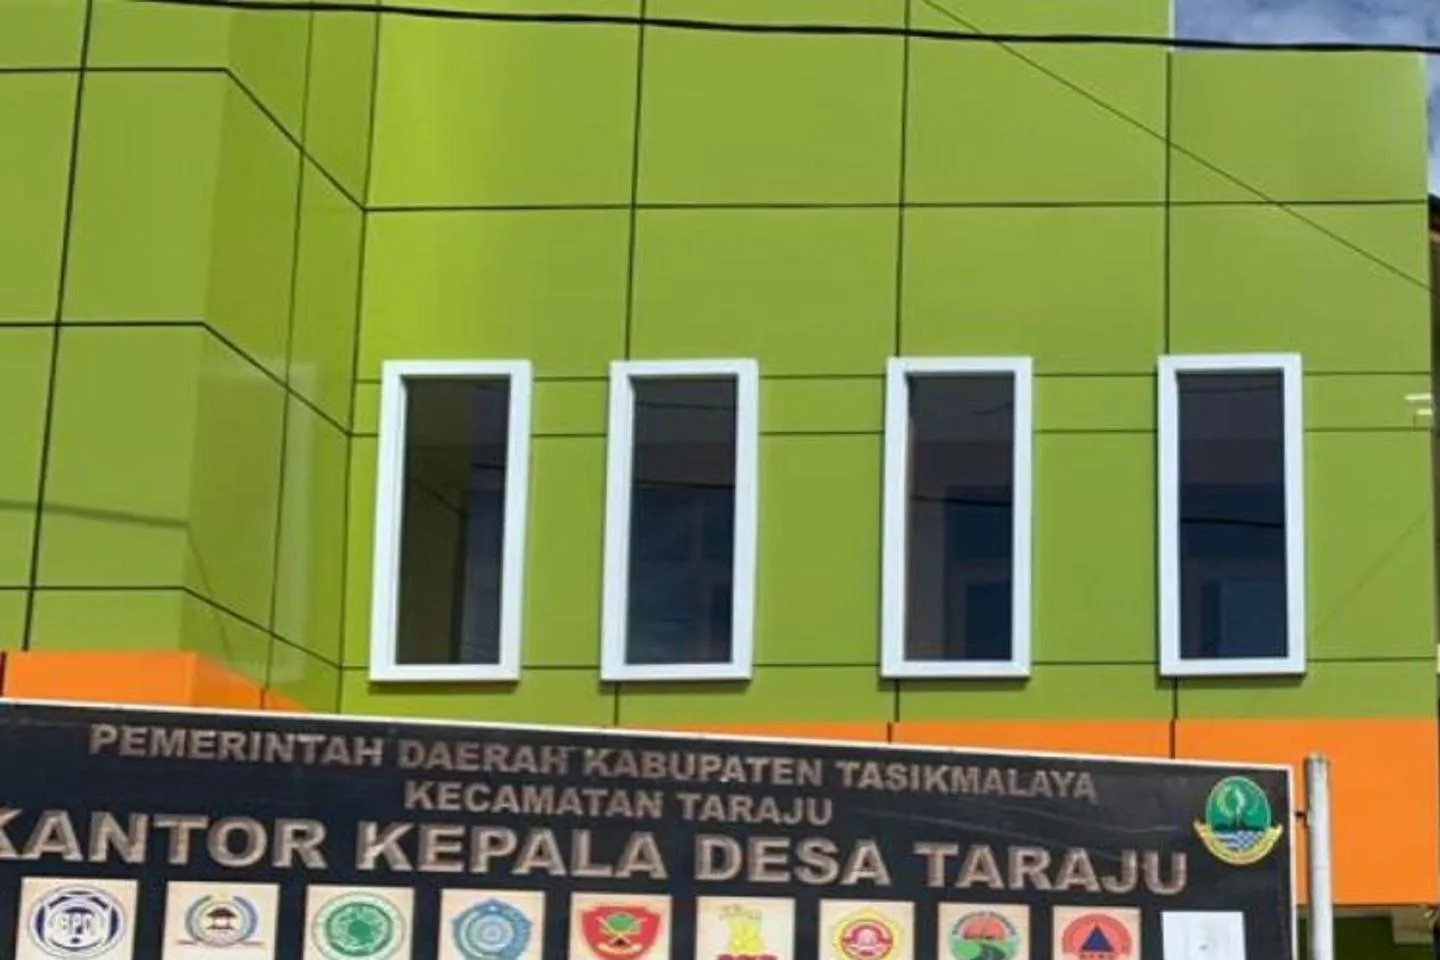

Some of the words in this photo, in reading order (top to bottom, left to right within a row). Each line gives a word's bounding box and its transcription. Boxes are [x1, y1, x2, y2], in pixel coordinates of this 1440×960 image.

[88, 723, 384, 767] PEMERINTAH
[400, 739, 566, 776] DAERAH
[583, 748, 823, 787] KABUPATEN
[836, 760, 1098, 804] TASIKMALAYA
[404, 780, 662, 819] KECAMATAN
[677, 793, 833, 826] TARAJU
[355, 820, 669, 879] KEPALA
[694, 834, 892, 886] DESA
[913, 842, 1188, 896] TARAJU
